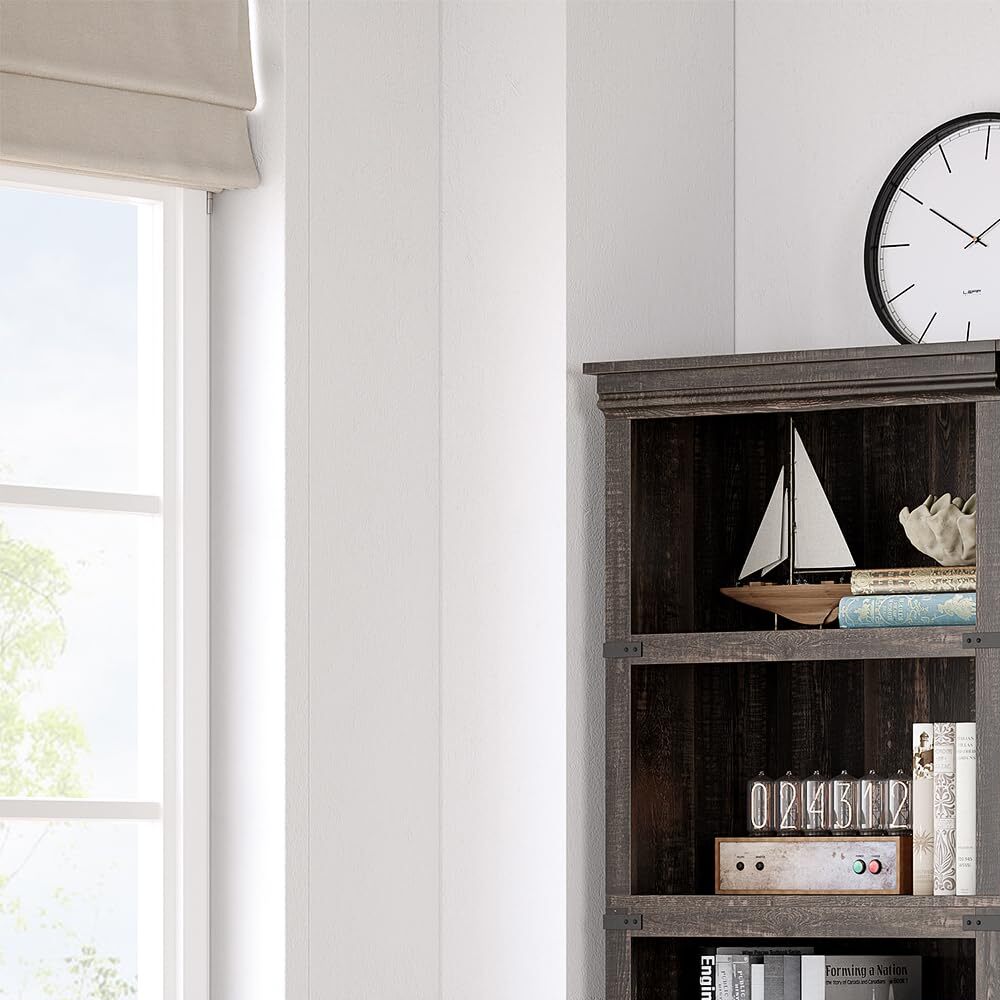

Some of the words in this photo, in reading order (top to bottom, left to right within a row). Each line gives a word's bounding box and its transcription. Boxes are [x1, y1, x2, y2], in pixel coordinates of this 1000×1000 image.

[825, 964, 867, 978] Forming
[869, 967, 875, 976] a
[877, 964, 908, 976] Nation
[737, 970, 746, 998] PUBLIC
